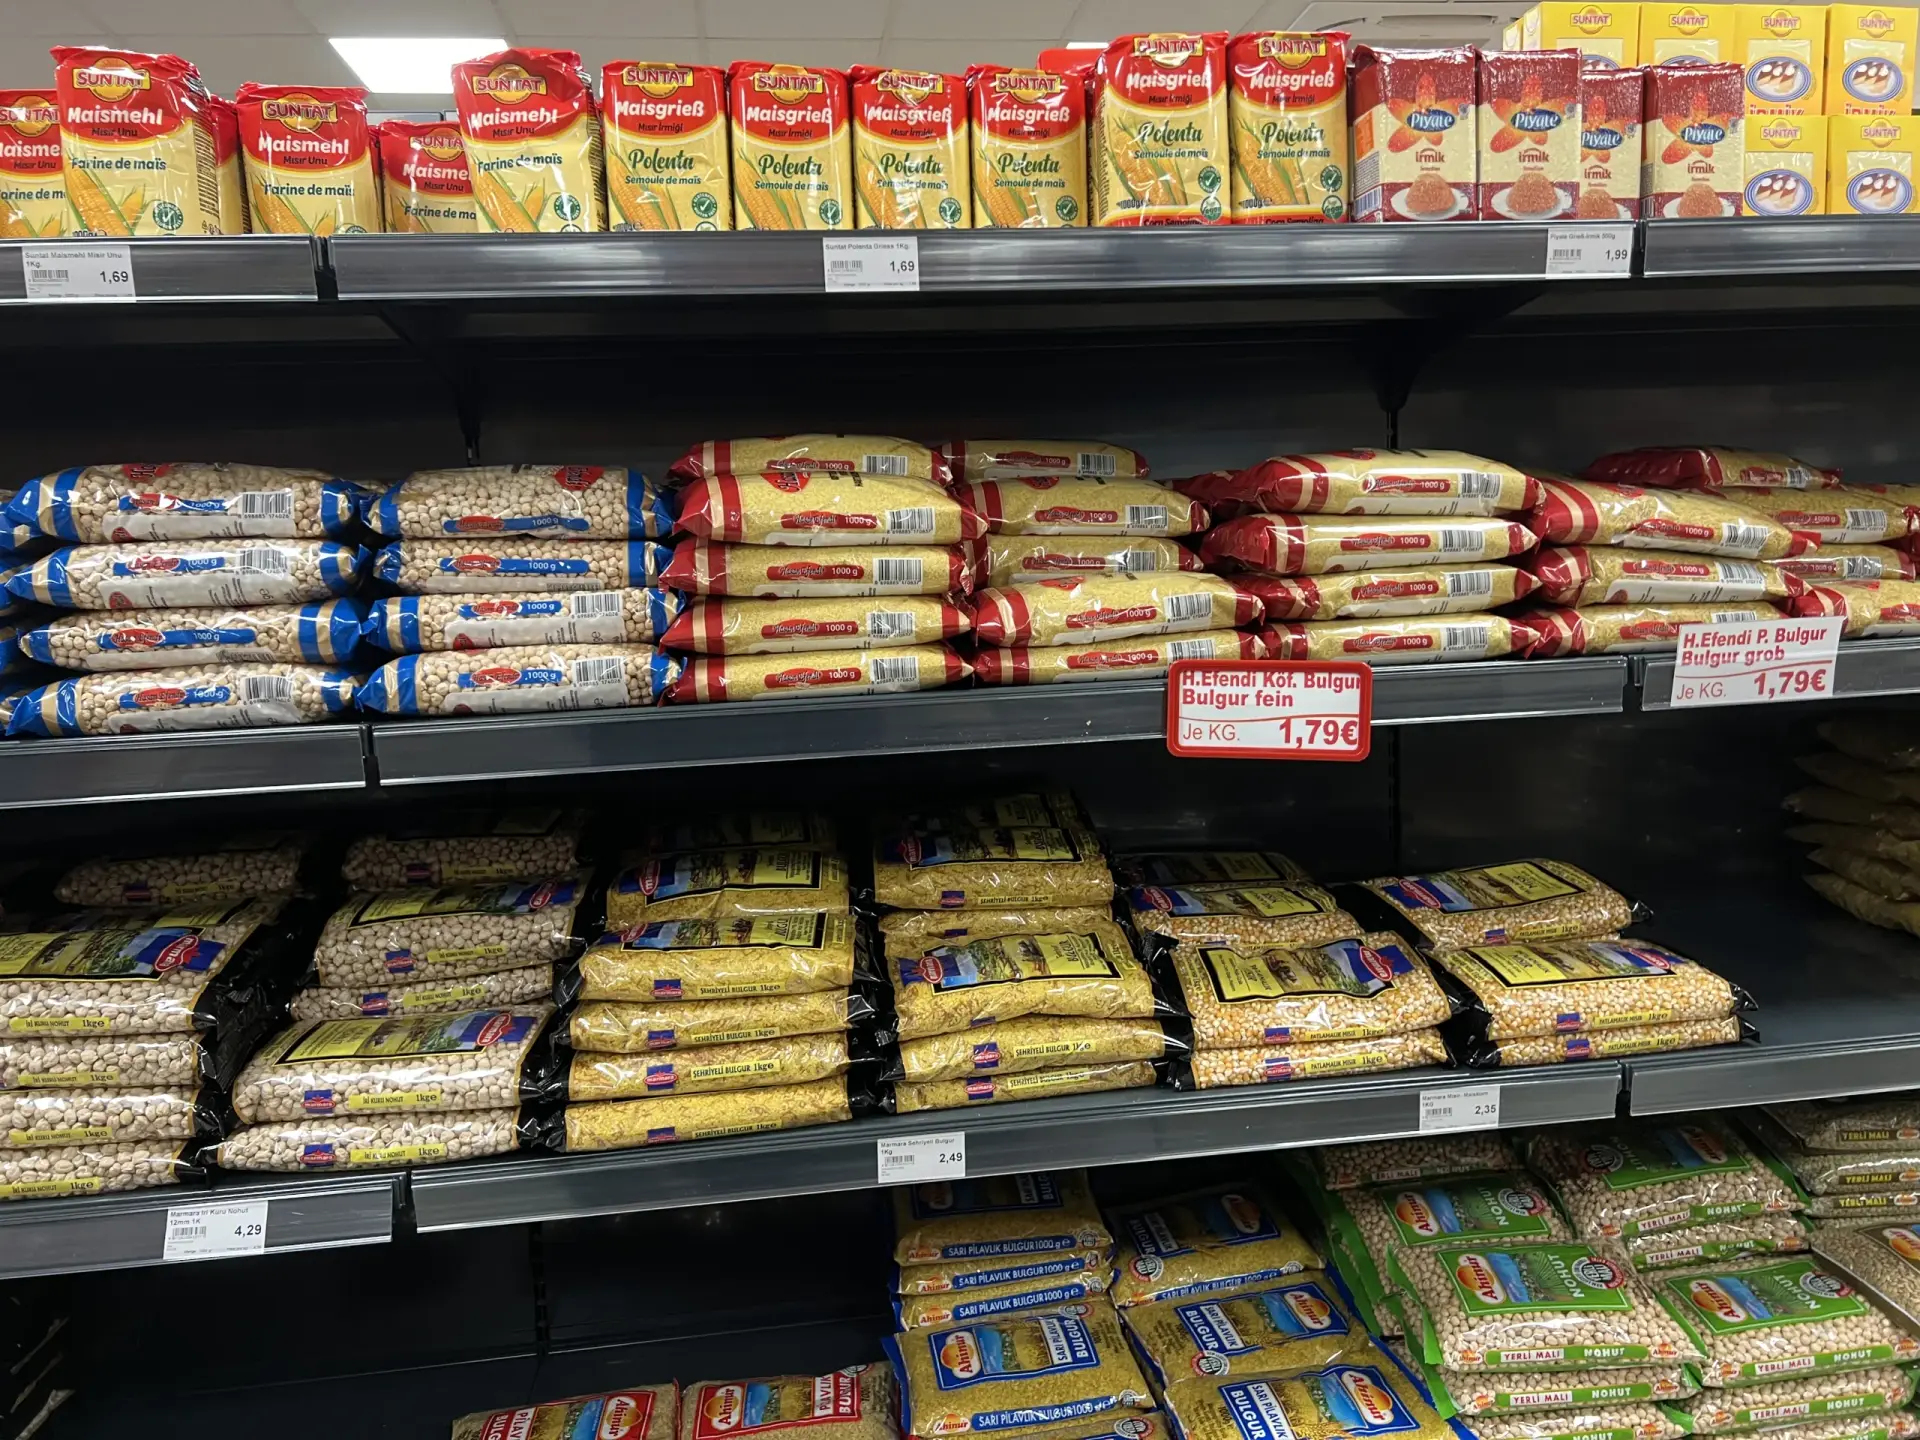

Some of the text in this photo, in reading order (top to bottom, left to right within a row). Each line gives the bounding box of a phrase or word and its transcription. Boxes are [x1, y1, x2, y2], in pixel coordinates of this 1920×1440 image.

[1573, 16, 1610, 26] SUNTAT
[1672, 16, 1707, 26] SUNTAT
[1764, 18, 1799, 28] SUNTAT
[1861, 19, 1893, 29] SUNTAT
[1263, 39, 1321, 53] SUNTAT
[626, 69, 690, 83] SUNTAT
[756, 75, 819, 90] SUNTAT
[880, 75, 939, 89] SUNTAT
[999, 75, 1057, 89] SUNTAT
[1126, 72, 1211, 90] Maisgrieß
[1250, 72, 1334, 89] Maisgrieß
[476, 78, 543, 94] SUNTAT
[68, 106, 163, 126] Maismehl
[265, 102, 333, 120] SUNTAT
[615, 101, 704, 119] Maisgrieß
[747, 106, 832, 125] Maisgrieß
[868, 105, 952, 124] Maisgrieß
[987, 104, 1070, 123] Maisgrieß
[471, 106, 558, 130] Maismehl
[1138, 120, 1203, 148] Polenta
[1261, 121, 1325, 147] Polenta
[1763, 128, 1799, 139] SUNTAT
[1863, 128, 1898, 139] SUNTAT
[259, 135, 349, 155] Maismehl
[71, 157, 167, 171] Farine de maïs
[478, 153, 562, 173] Farine de maïs
[628, 147, 694, 172] Polenta
[758, 153, 823, 178] Polenta
[881, 152, 943, 177] Polenta
[997, 152, 1060, 177] Polenta
[625, 175, 701, 185] Semoule de maïs
[754, 180, 806, 191] Semoule de
[994, 178, 1044, 188] Semoule de
[265, 184, 306, 197] Farine
[308, 183, 324, 197] de
[1605, 249, 1628, 262] 1,99
[889, 261, 915, 274] 1,69
[99, 270, 129, 284] 1,69
[532, 517, 550, 527] 1000
[844, 516, 864, 525] 1000
[1685, 526, 1702, 535] 1000
[1400, 536, 1417, 545] 1000
[527, 562, 548, 570] 1000
[832, 567, 851, 575] 1000
[1679, 566, 1697, 574] 1000
[1409, 584, 1425, 592] 1000
[527, 602, 547, 611] 1000
[1125, 609, 1142, 619] 1000
[825, 624, 845, 632] 1000
[1403, 638, 1419, 646] 1000
[1683, 627, 1827, 649] H.Efendi P. Bulgur
[1127, 653, 1146, 662] 1000
[1682, 645, 1785, 668] Bulgur grob
[528, 671, 548, 680] 1000
[828, 671, 848, 680] 1000
[1183, 671, 1360, 694] H.Efendi Köf. Bulgur
[1677, 682, 1727, 700] Je KG.
[1754, 668, 1827, 700] 1,79€
[1183, 688, 1294, 709] Bulgur fein
[1183, 716, 1359, 749] Je KG. 1,79€
[731, 984, 758, 994] BULGUR
[726, 1030, 752, 1042] BULGUR
[1045, 1044, 1070, 1054] BULGUR
[725, 1065, 752, 1075] BULGUR
[1475, 1104, 1497, 1116] 2,35
[727, 1125, 754, 1136] BULGUR
[881, 1141, 907, 1149] Marmara
[939, 1152, 963, 1164] 2,49
[170, 1207, 249, 1218] Marmara Kuru Nohut
[1403, 1192, 1434, 1234] Ahinur
[170, 1218, 201, 1226] 12mm 1K
[1640, 1217, 1666, 1231] YERLİ
[234, 1224, 262, 1238] 4,29
[948, 1243, 1002, 1256] SARI PİLAVLIK
[1649, 1252, 1674, 1264] YERLİ
[920, 1270, 1011, 1293] Ahinur SARI PİLAVLIK
[1465, 1255, 1499, 1301] Ahinur
[1547, 1253, 1586, 1299] NOHUT
[1773, 1274, 1822, 1310] NOHUT
[1696, 1281, 1741, 1319] Ahinur
[920, 1298, 1012, 1324] Ahinur SARI PİLAVLIK
[1292, 1291, 1325, 1327] Ahinur
[1186, 1308, 1219, 1350] BULGUR
[1205, 1303, 1239, 1350] SARI PİLAVLIK
[1066, 1318, 1090, 1359] BULGUR
[957, 1334, 974, 1375] Ahinur
[1503, 1347, 1625, 1361] YERLİ MALI NOHUT
[1757, 1349, 1872, 1373] YERLİ MALI NOHUT
[1252, 1384, 1267, 1402] SARI
[1349, 1371, 1386, 1422] Ahinur
[1513, 1387, 1632, 1405] YERLİ MALI NOHUT
[718, 1387, 737, 1426] Ahinur
[1753, 1397, 1865, 1420] YERLİ NOHUT
[608, 1398, 631, 1437] Ahinur
[979, 1415, 999, 1427] SARI
